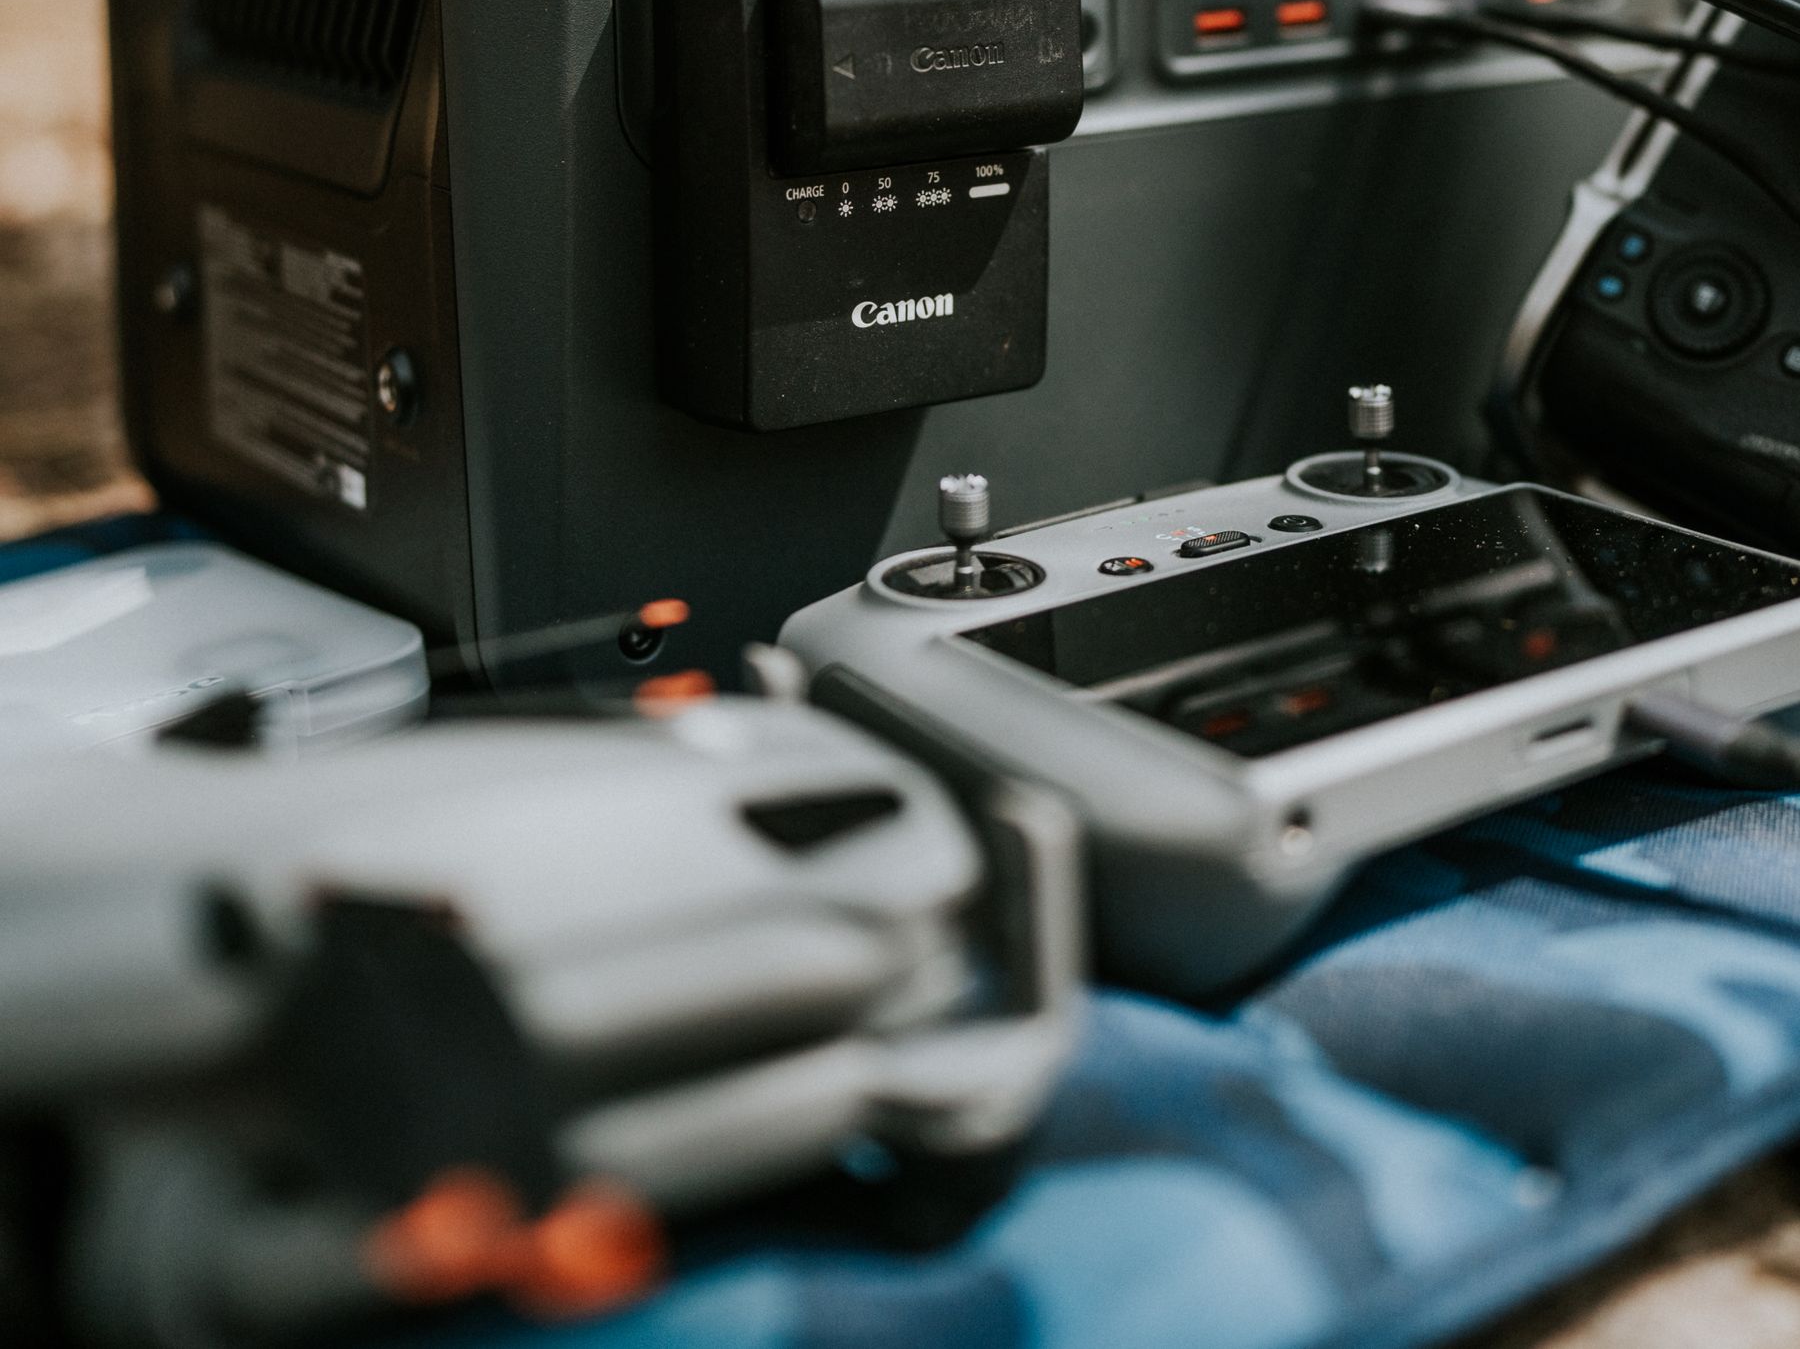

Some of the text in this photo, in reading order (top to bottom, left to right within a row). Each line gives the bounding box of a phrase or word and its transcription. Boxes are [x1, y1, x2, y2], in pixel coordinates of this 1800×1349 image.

[910, 46, 1005, 73] Canon
[786, 164, 1004, 201] CHARGE 0 50 75 100%
[851, 292, 954, 329] Canon
